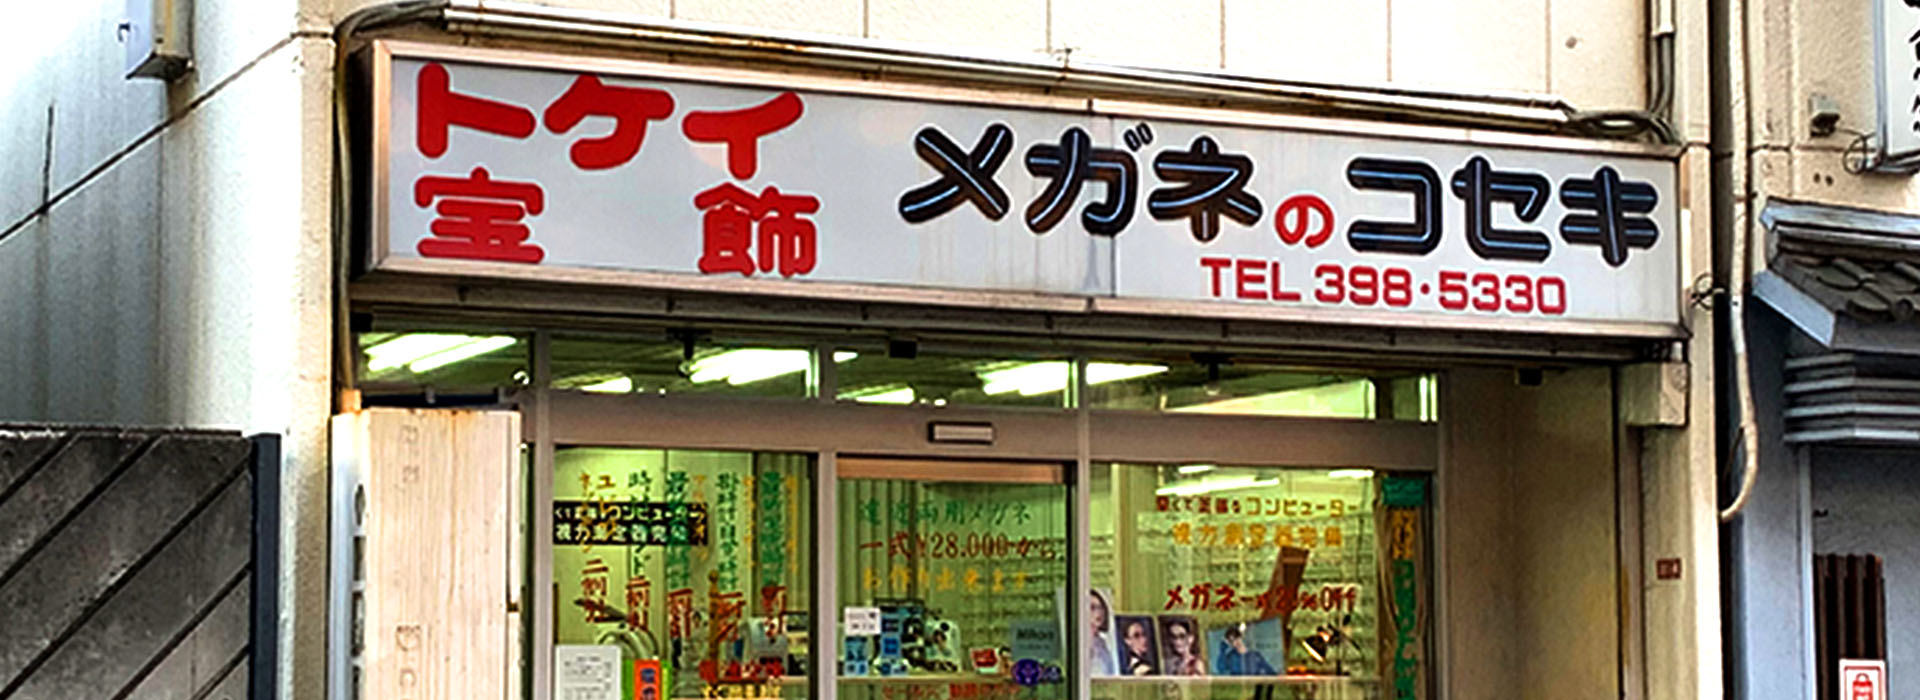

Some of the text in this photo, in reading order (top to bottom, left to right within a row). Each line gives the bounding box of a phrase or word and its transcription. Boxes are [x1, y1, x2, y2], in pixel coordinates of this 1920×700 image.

[416, 62, 804, 181] トケイ
[414, 166, 820, 278] 宝飾
[899, 122, 1660, 267] メガネのコセキ
[1201, 257, 1301, 301] TEL
